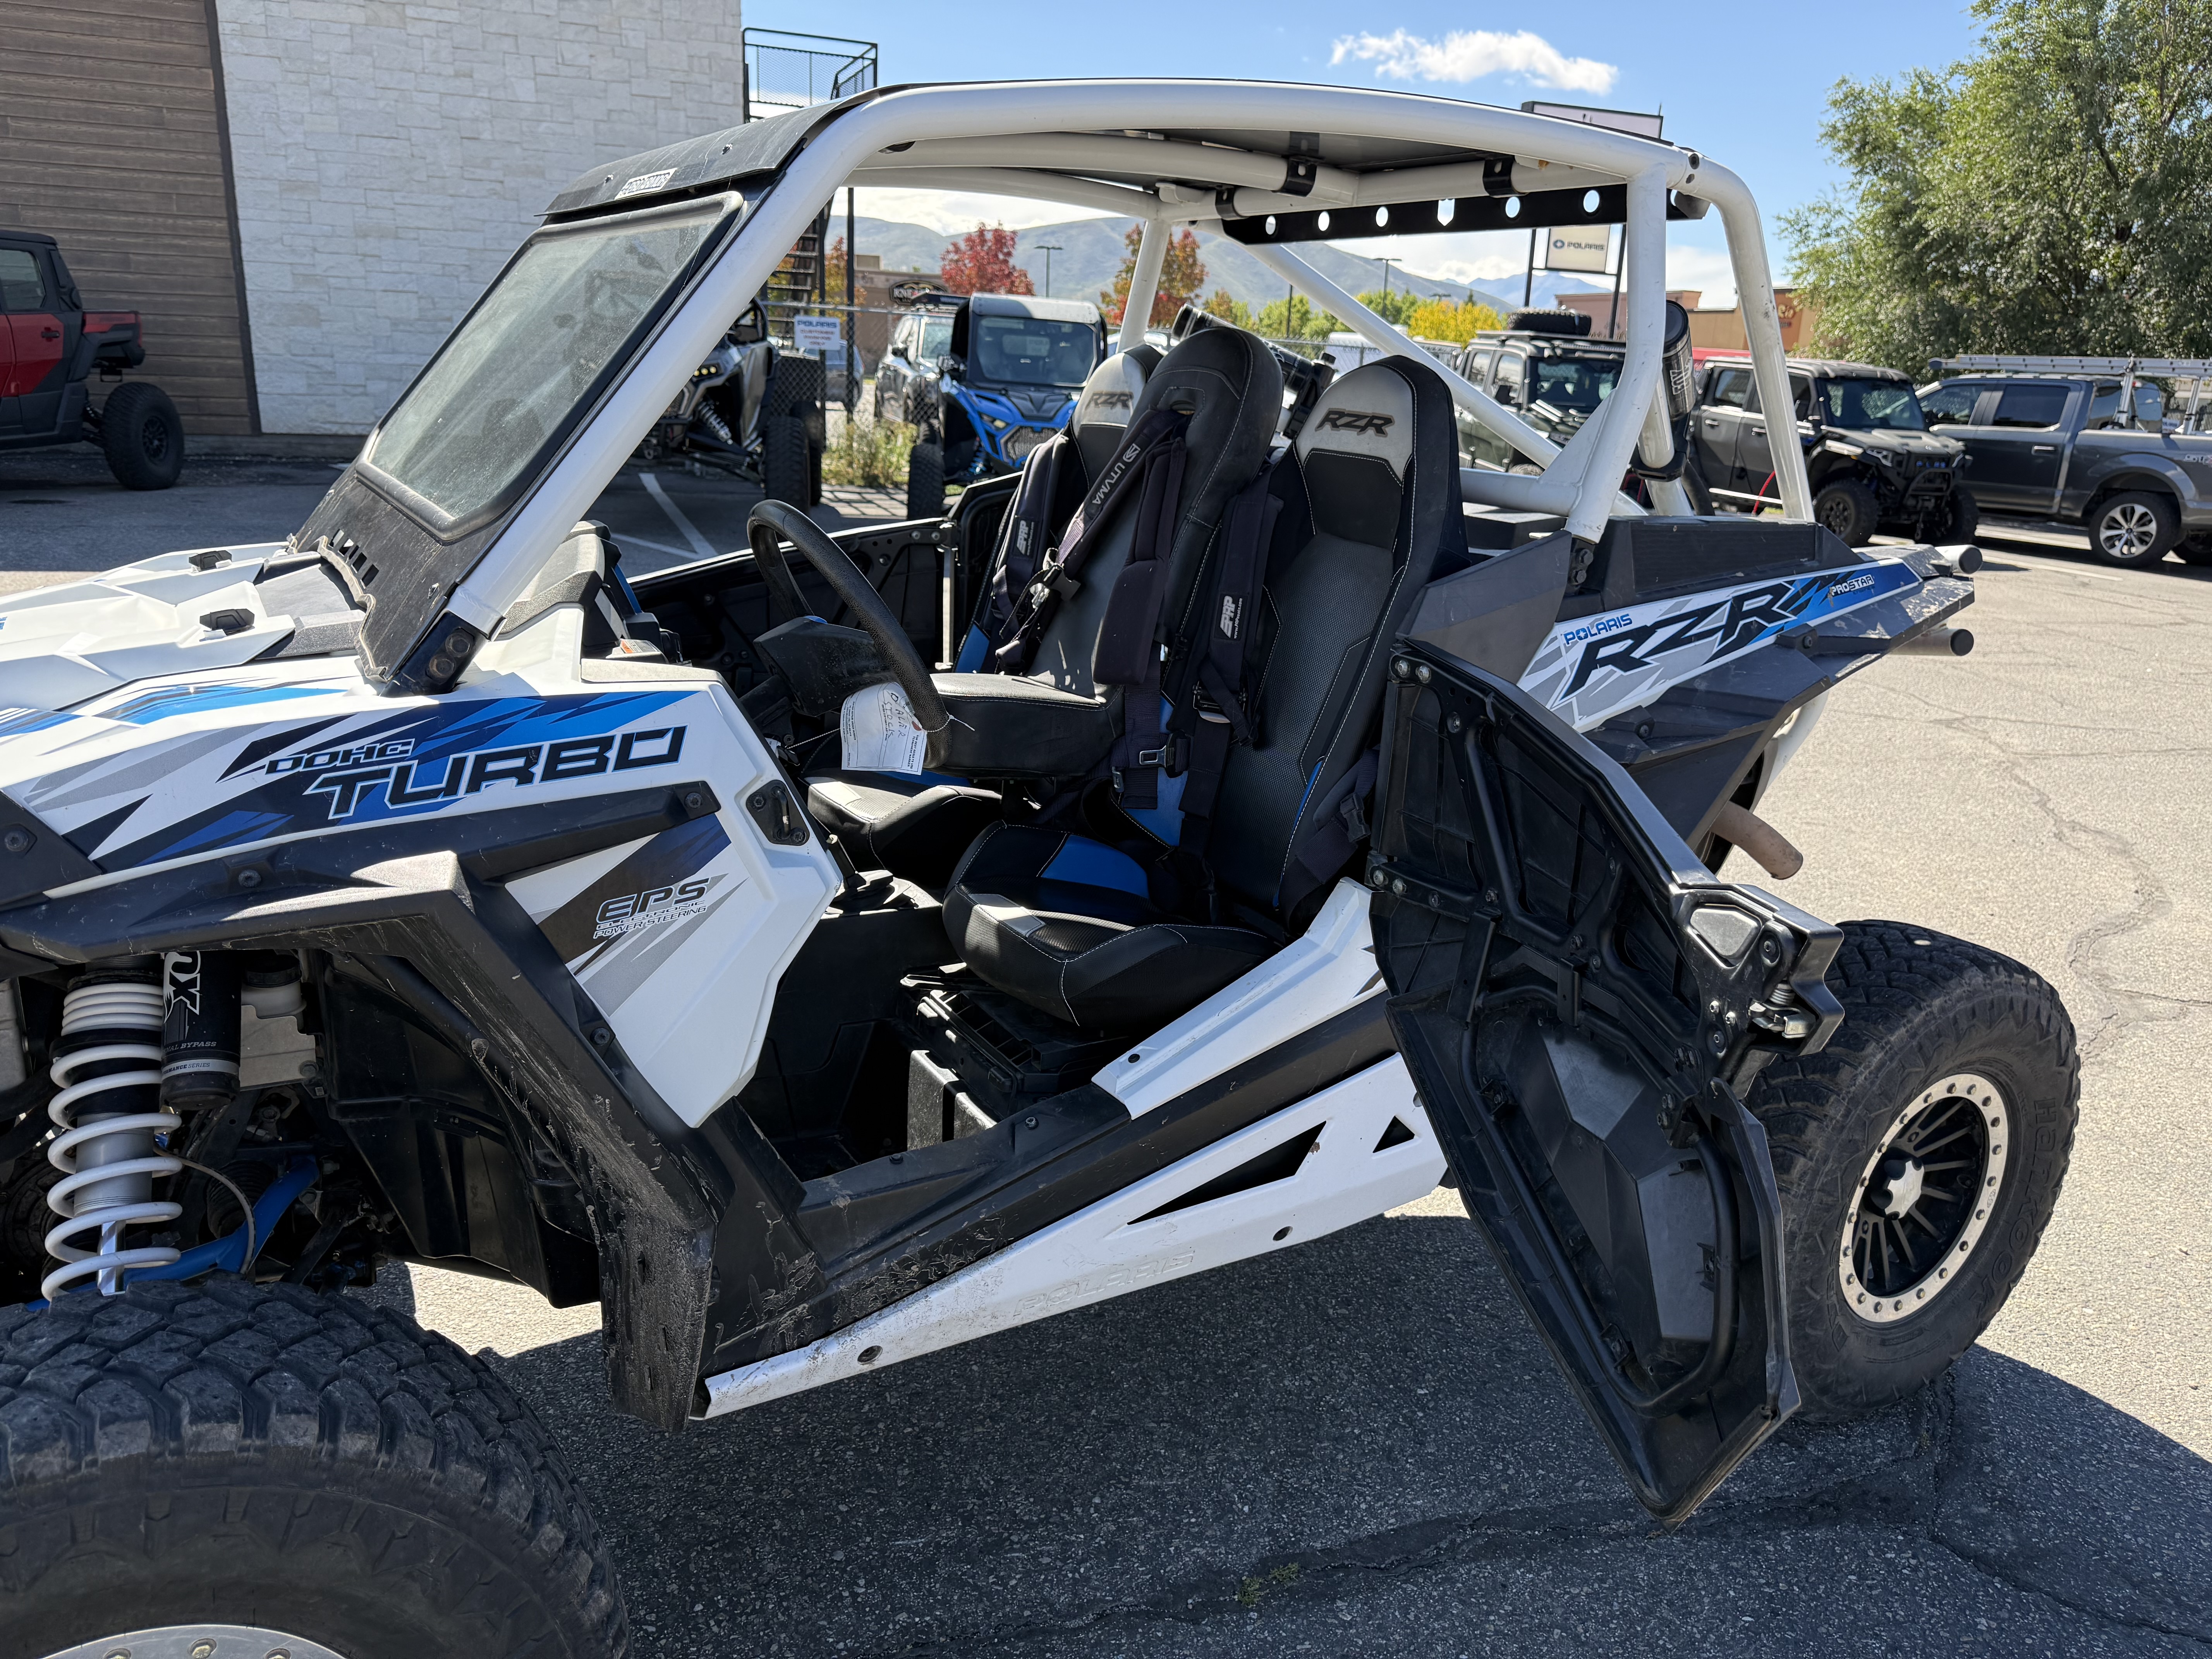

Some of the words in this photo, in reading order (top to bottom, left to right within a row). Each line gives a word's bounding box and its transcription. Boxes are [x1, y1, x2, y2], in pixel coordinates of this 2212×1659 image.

[1567, 241, 1605, 251] POLARIS
[797, 320, 837, 328] POLARIS
[1085, 392, 1134, 410] RZR
[1315, 408, 1395, 437] RZR
[1092, 462, 1125, 504] UTVMA
[1017, 520, 1029, 555] PRP
[1831, 575, 1874, 596] PROSTAR
[1220, 596, 1236, 638] PRP
[1565, 613, 1632, 646] POLARIS
[1559, 580, 1799, 701] RZR
[883, 700, 894, 738] STOCK
[265, 738, 416, 775] DOHC
[302, 725, 689, 820] TURBO
[596, 877, 711, 924] EPS
[596, 900, 705, 930] ELECTRONIC
[593, 921, 644, 939] POWER
[645, 905, 707, 926] STEERING
[1012, 1249, 1195, 1320] POLARIS
